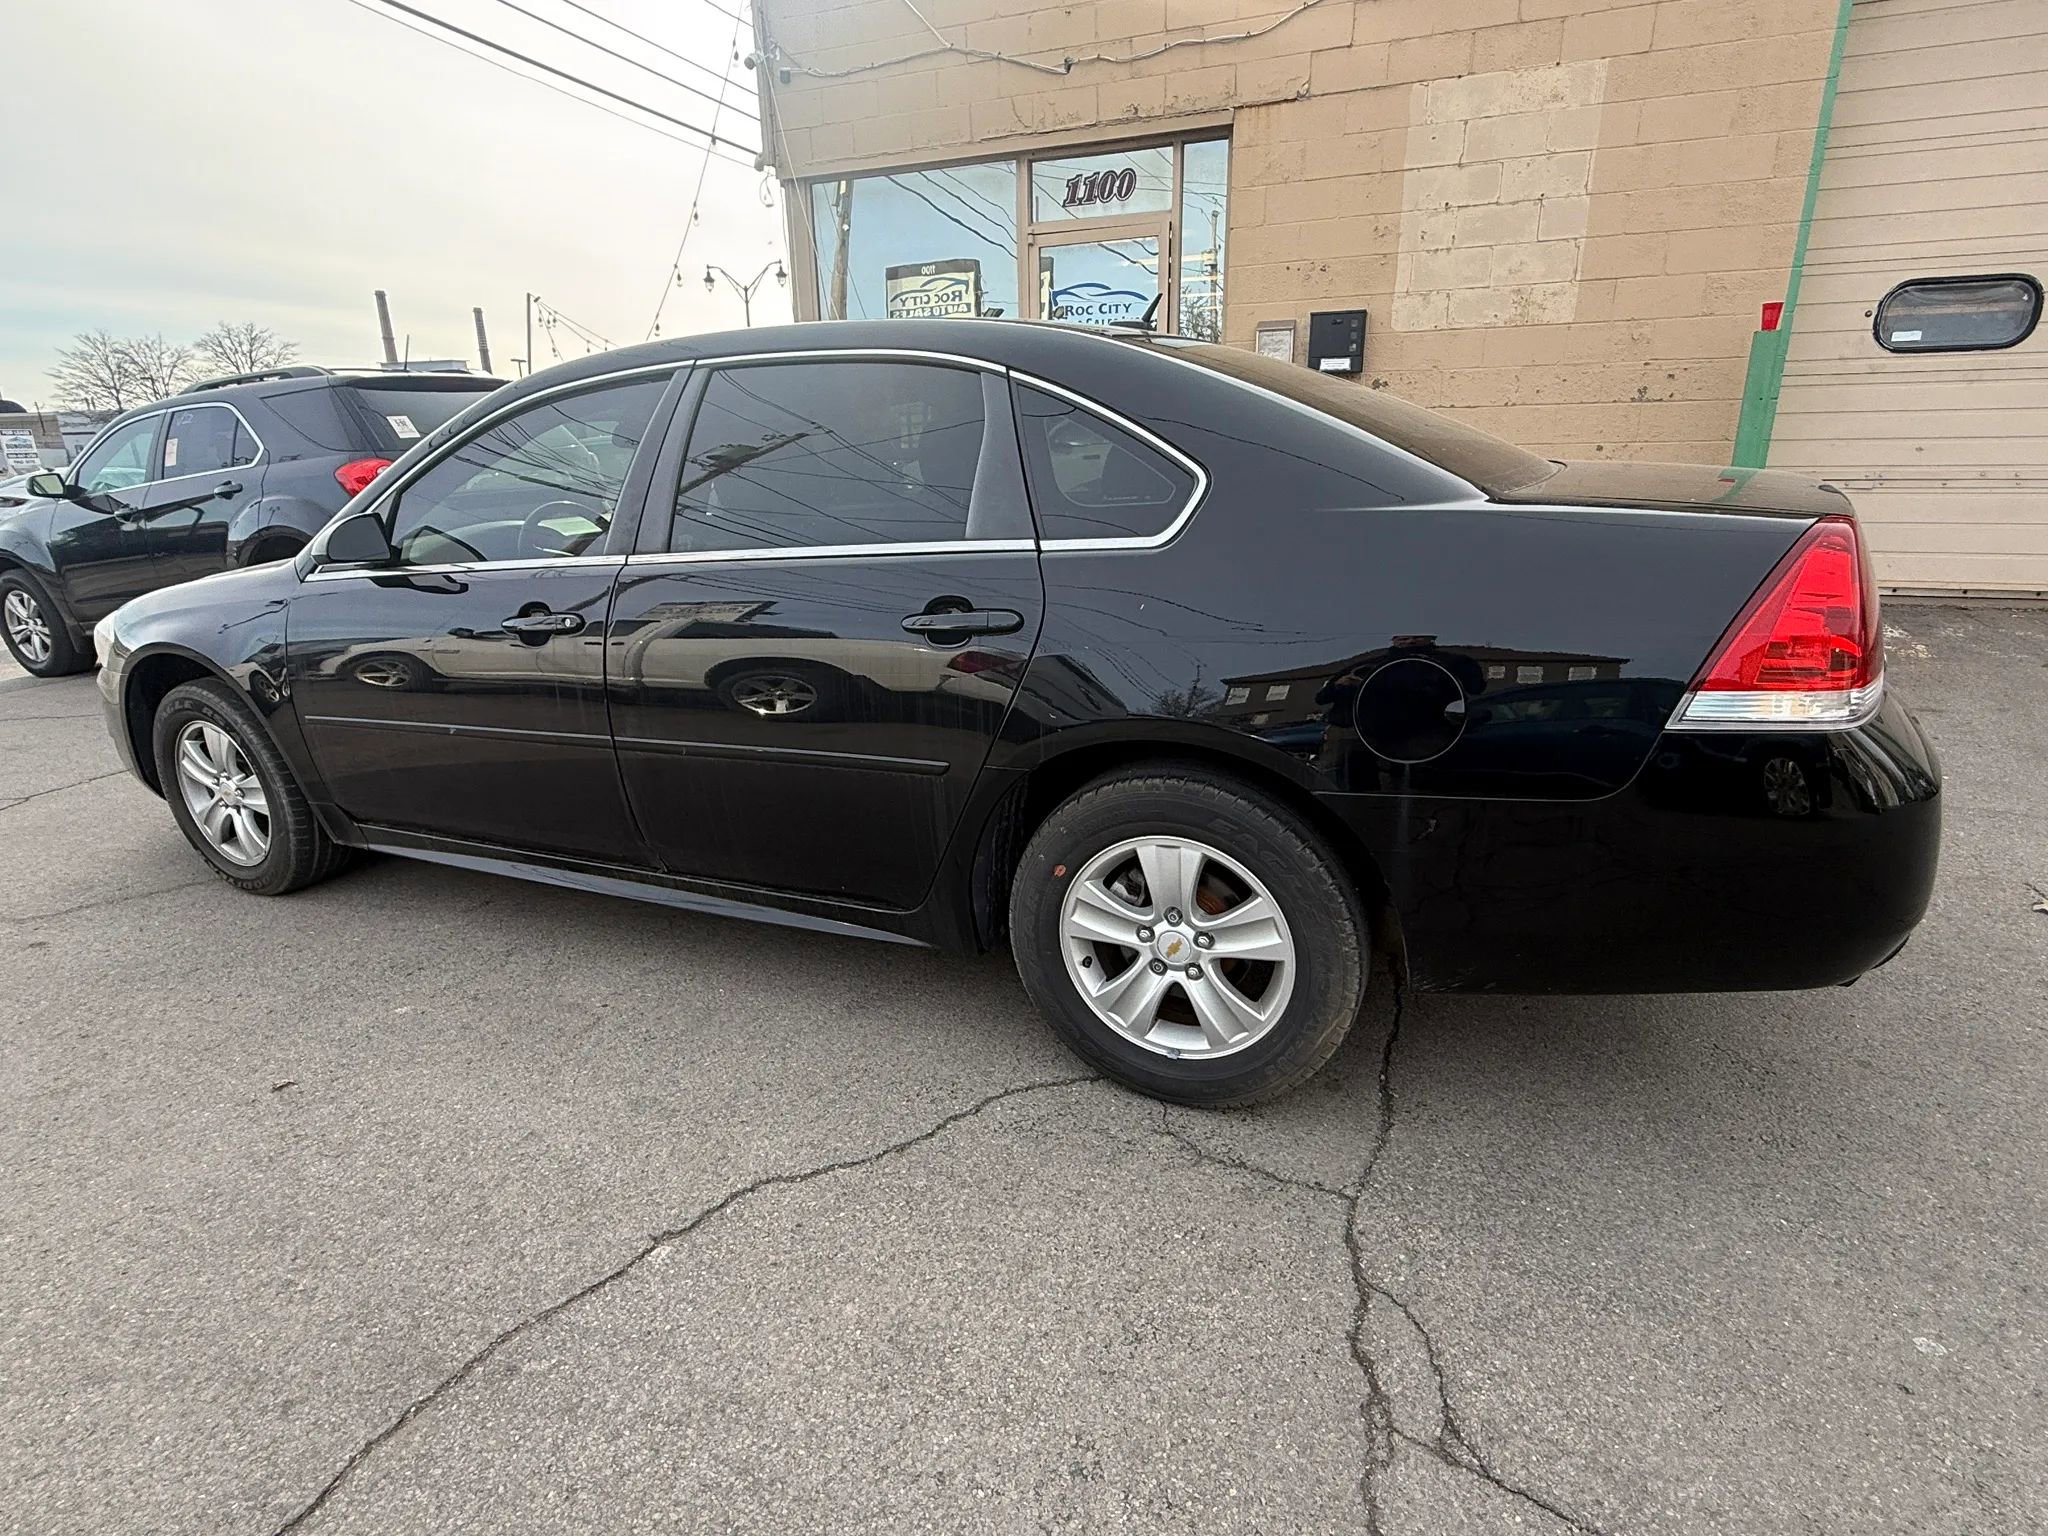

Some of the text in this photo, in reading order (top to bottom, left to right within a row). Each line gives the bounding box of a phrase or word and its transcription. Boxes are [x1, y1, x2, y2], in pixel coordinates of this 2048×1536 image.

[1062, 168, 1136, 207] 1100
[1065, 303, 1132, 317] ROC CITY
